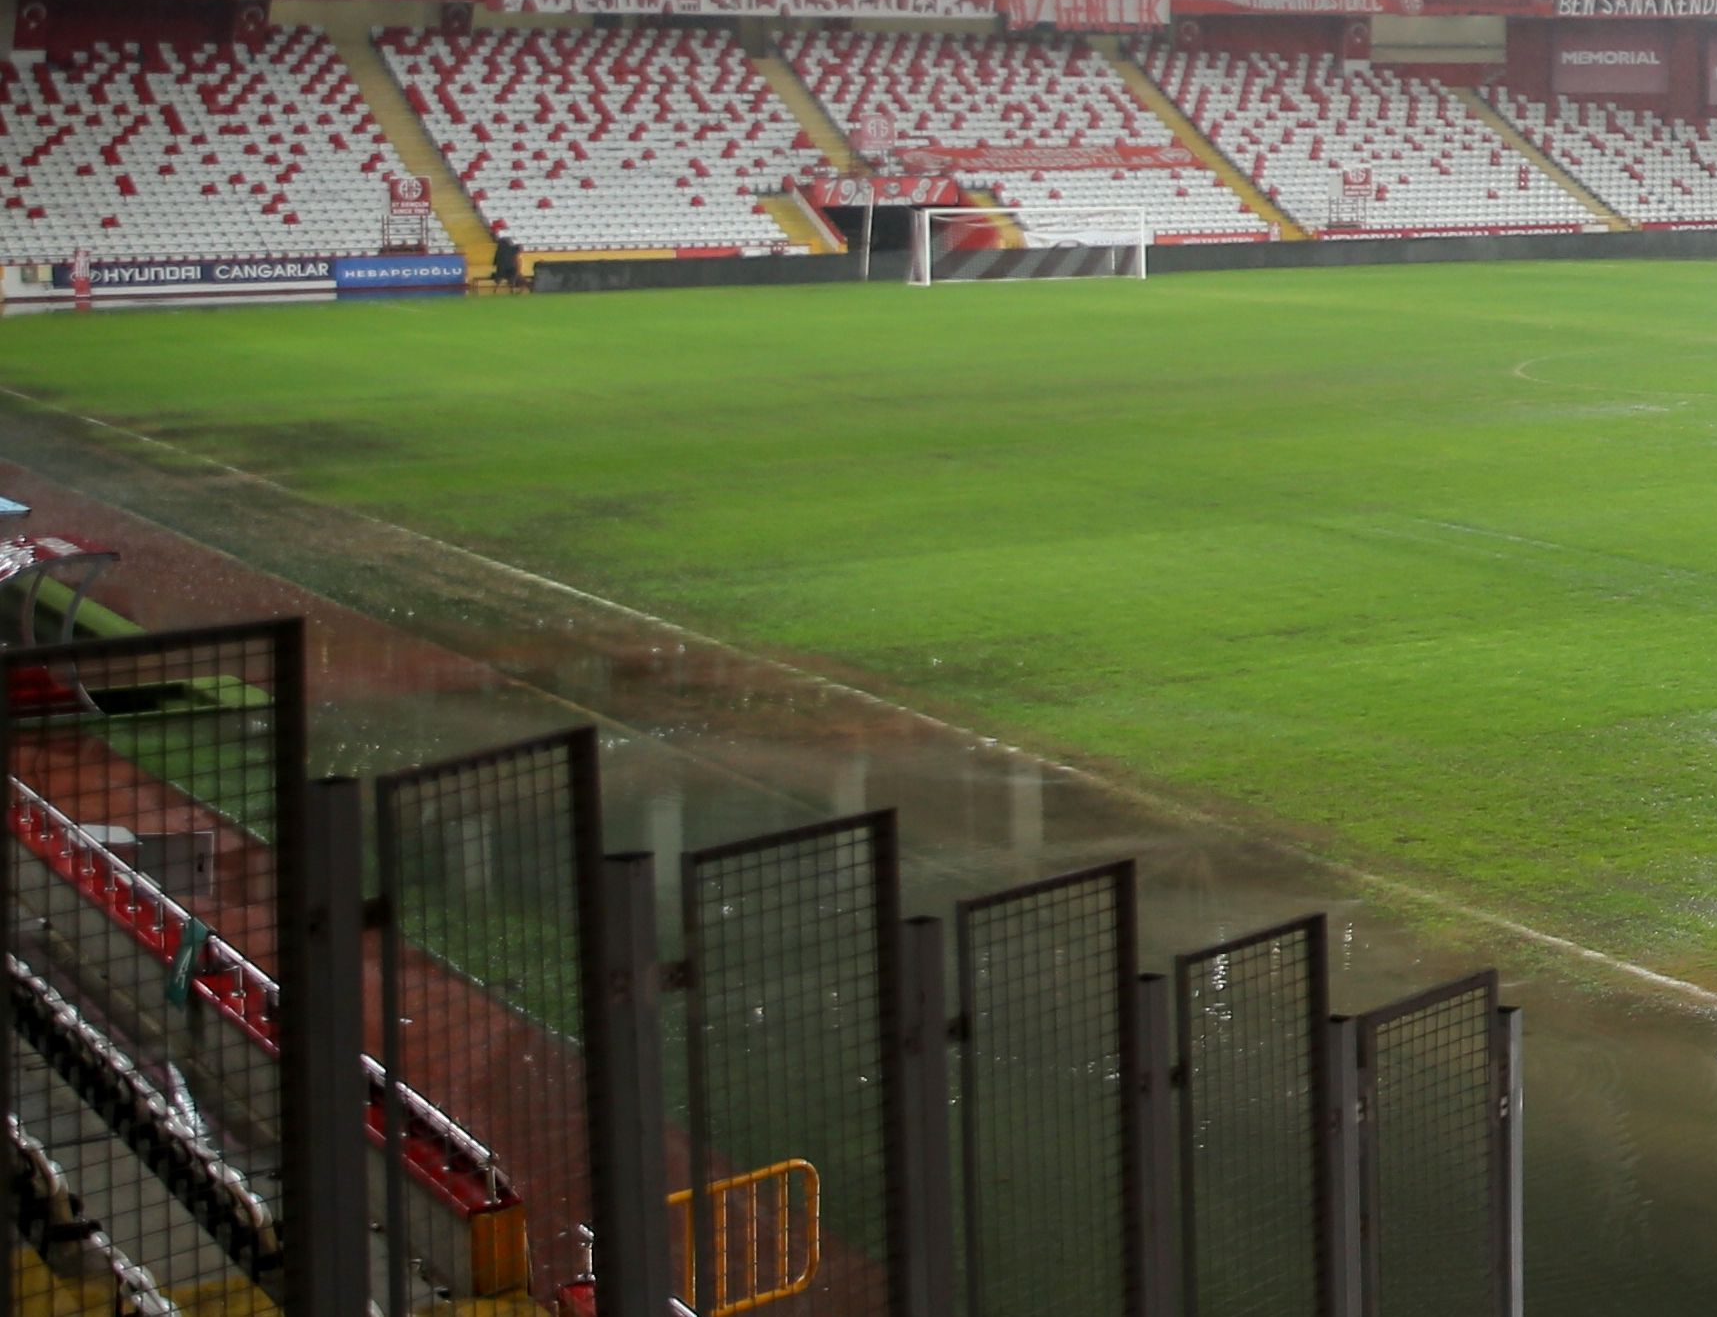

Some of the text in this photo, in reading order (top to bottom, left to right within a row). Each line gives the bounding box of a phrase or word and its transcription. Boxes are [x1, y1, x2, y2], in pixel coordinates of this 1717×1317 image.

[1562, 50, 1660, 65] MEMORIAL
[103, 266, 202, 283] HYUNDAI
[215, 262, 330, 280] CANGARLAR
